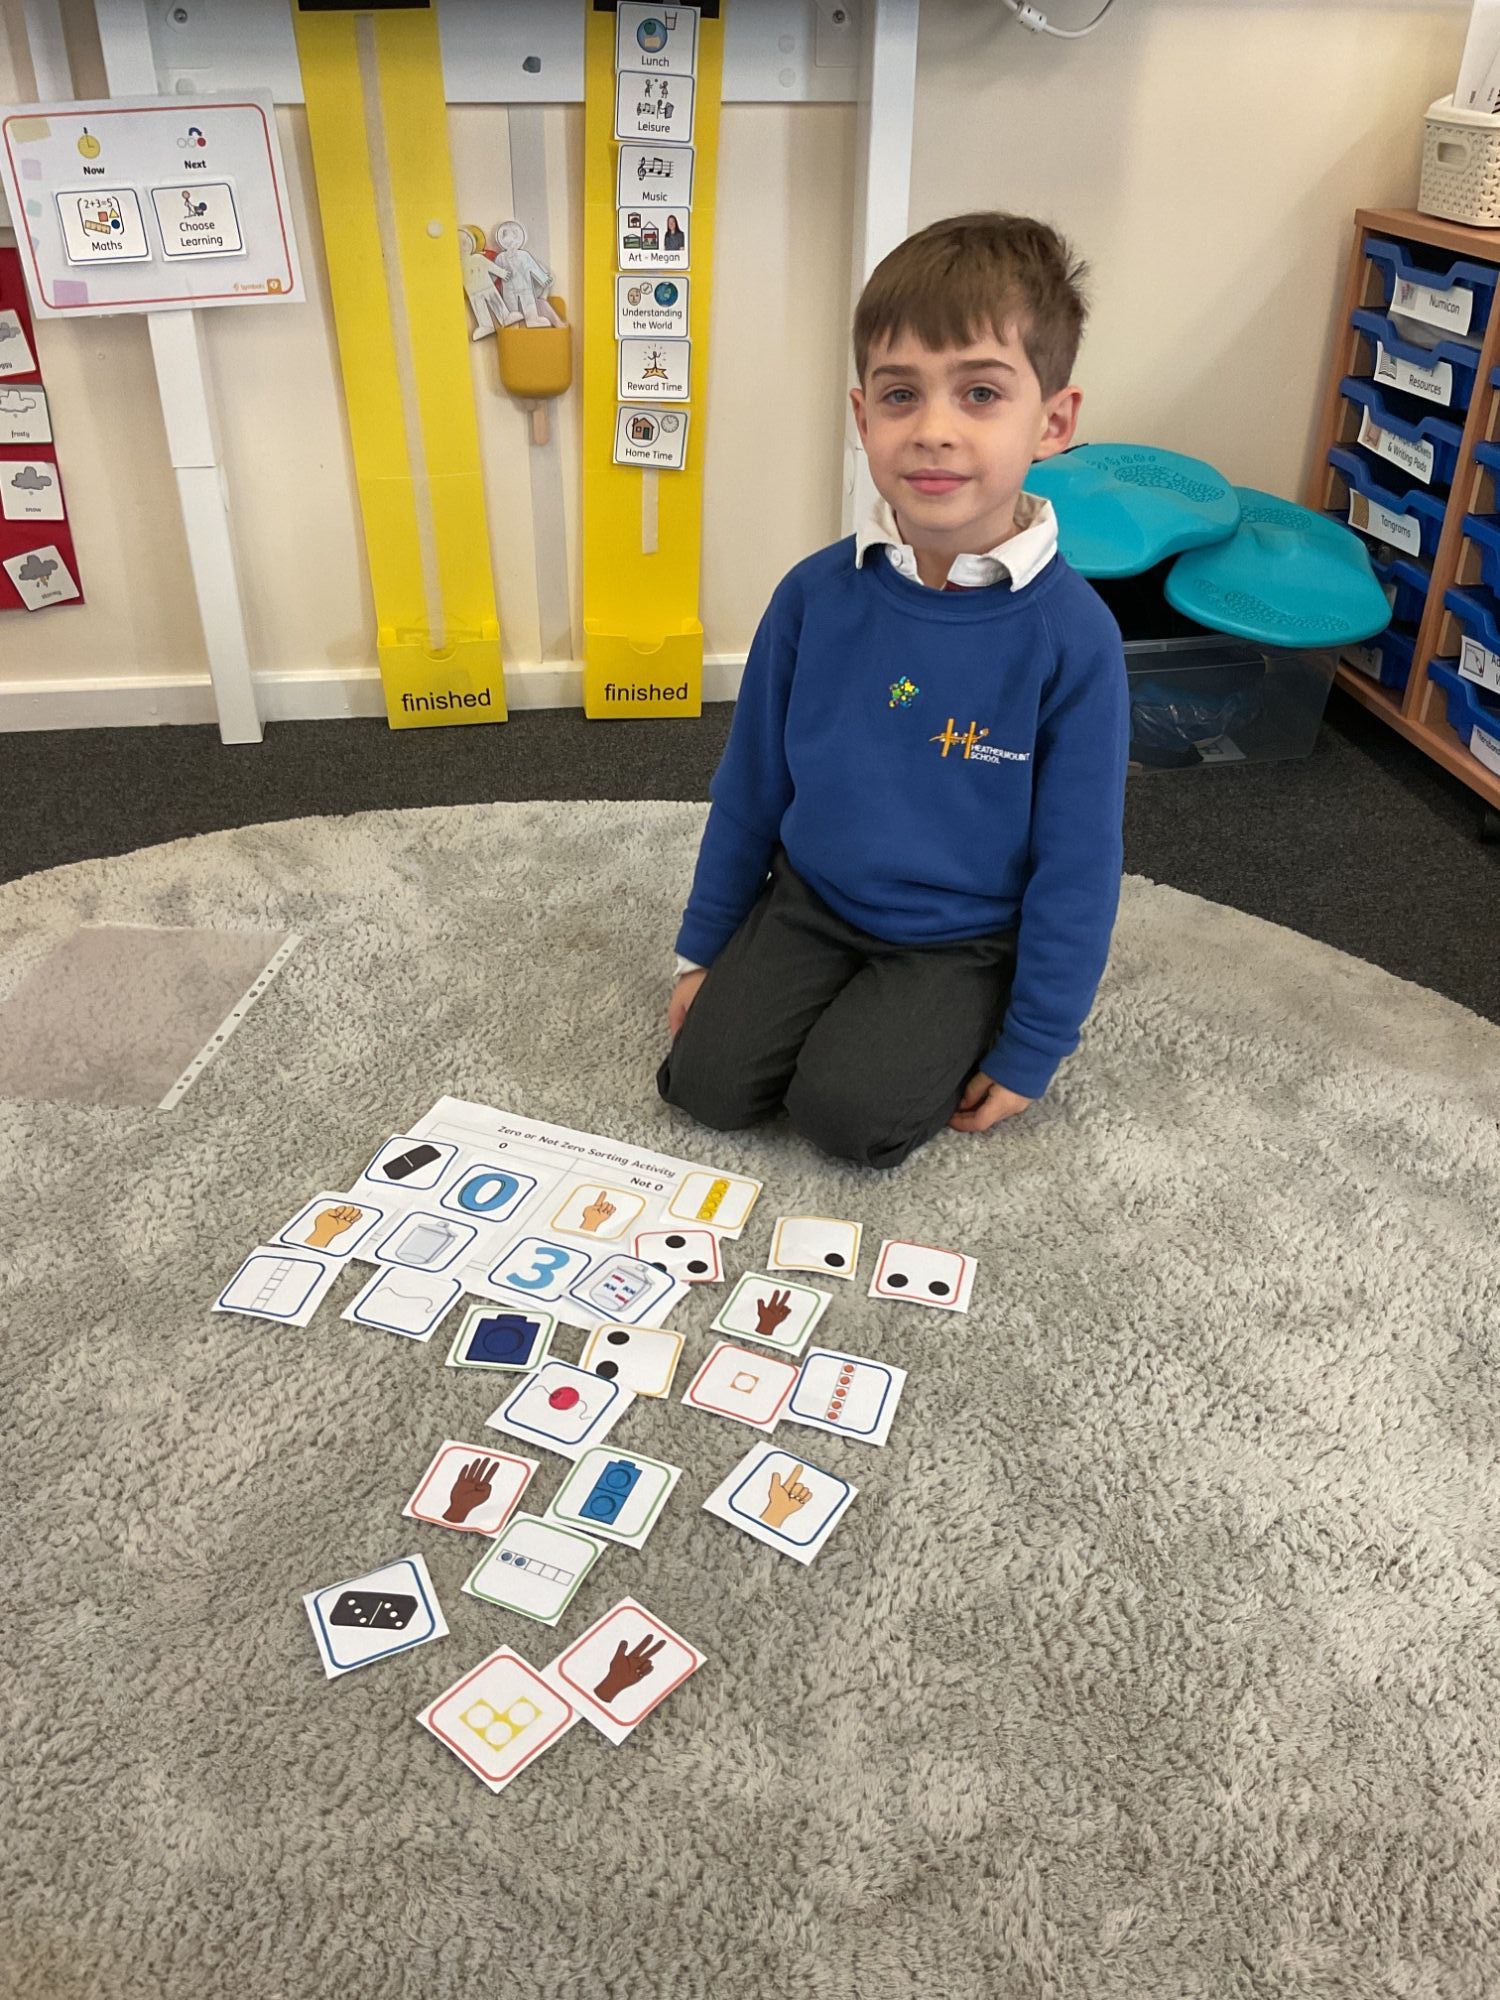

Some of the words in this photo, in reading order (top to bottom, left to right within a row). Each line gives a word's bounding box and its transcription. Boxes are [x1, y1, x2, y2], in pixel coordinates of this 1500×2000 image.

[641, 55, 670, 67] Lunch
[638, 121, 670, 133] Leisure
[83, 166, 105, 175] Now
[184, 159, 207, 170] Next
[642, 191, 668, 202] Music
[179, 220, 215, 232] Choose
[91, 240, 123, 251] Maths
[181, 235, 223, 247] Learning
[628, 253, 642, 262] Art
[651, 253, 680, 263] Megan
[1429, 295, 1460, 315] Numicon
[622, 308, 682, 319] Understanding
[633, 321, 646, 329] the
[649, 321, 673, 330] World
[627, 381, 659, 391] Reward
[661, 383, 683, 392] Time
[1409, 374, 1442, 395] Resources
[625, 448, 650, 459] Home
[652, 450, 673, 461] Time
[1387, 441, 1392, 452] &
[1393, 444, 1413, 466] Writing
[1413, 456, 1427, 473] Pads
[1381, 515, 1411, 538] Tangrams
[604, 682, 688, 702] finished
[401, 688, 491, 712] finished
[970, 751, 1000, 764] SCHOOL
[497, 1125, 522, 1137] Zero
[539, 1135, 559, 1146] Not
[560, 1141, 585, 1153] Zero
[588, 1148, 629, 1166] Sorting
[631, 1160, 676, 1179] Activity
[630, 1176, 652, 1189] Not
[457, 1172, 520, 1212] 0
[506, 1246, 570, 1290] 3
